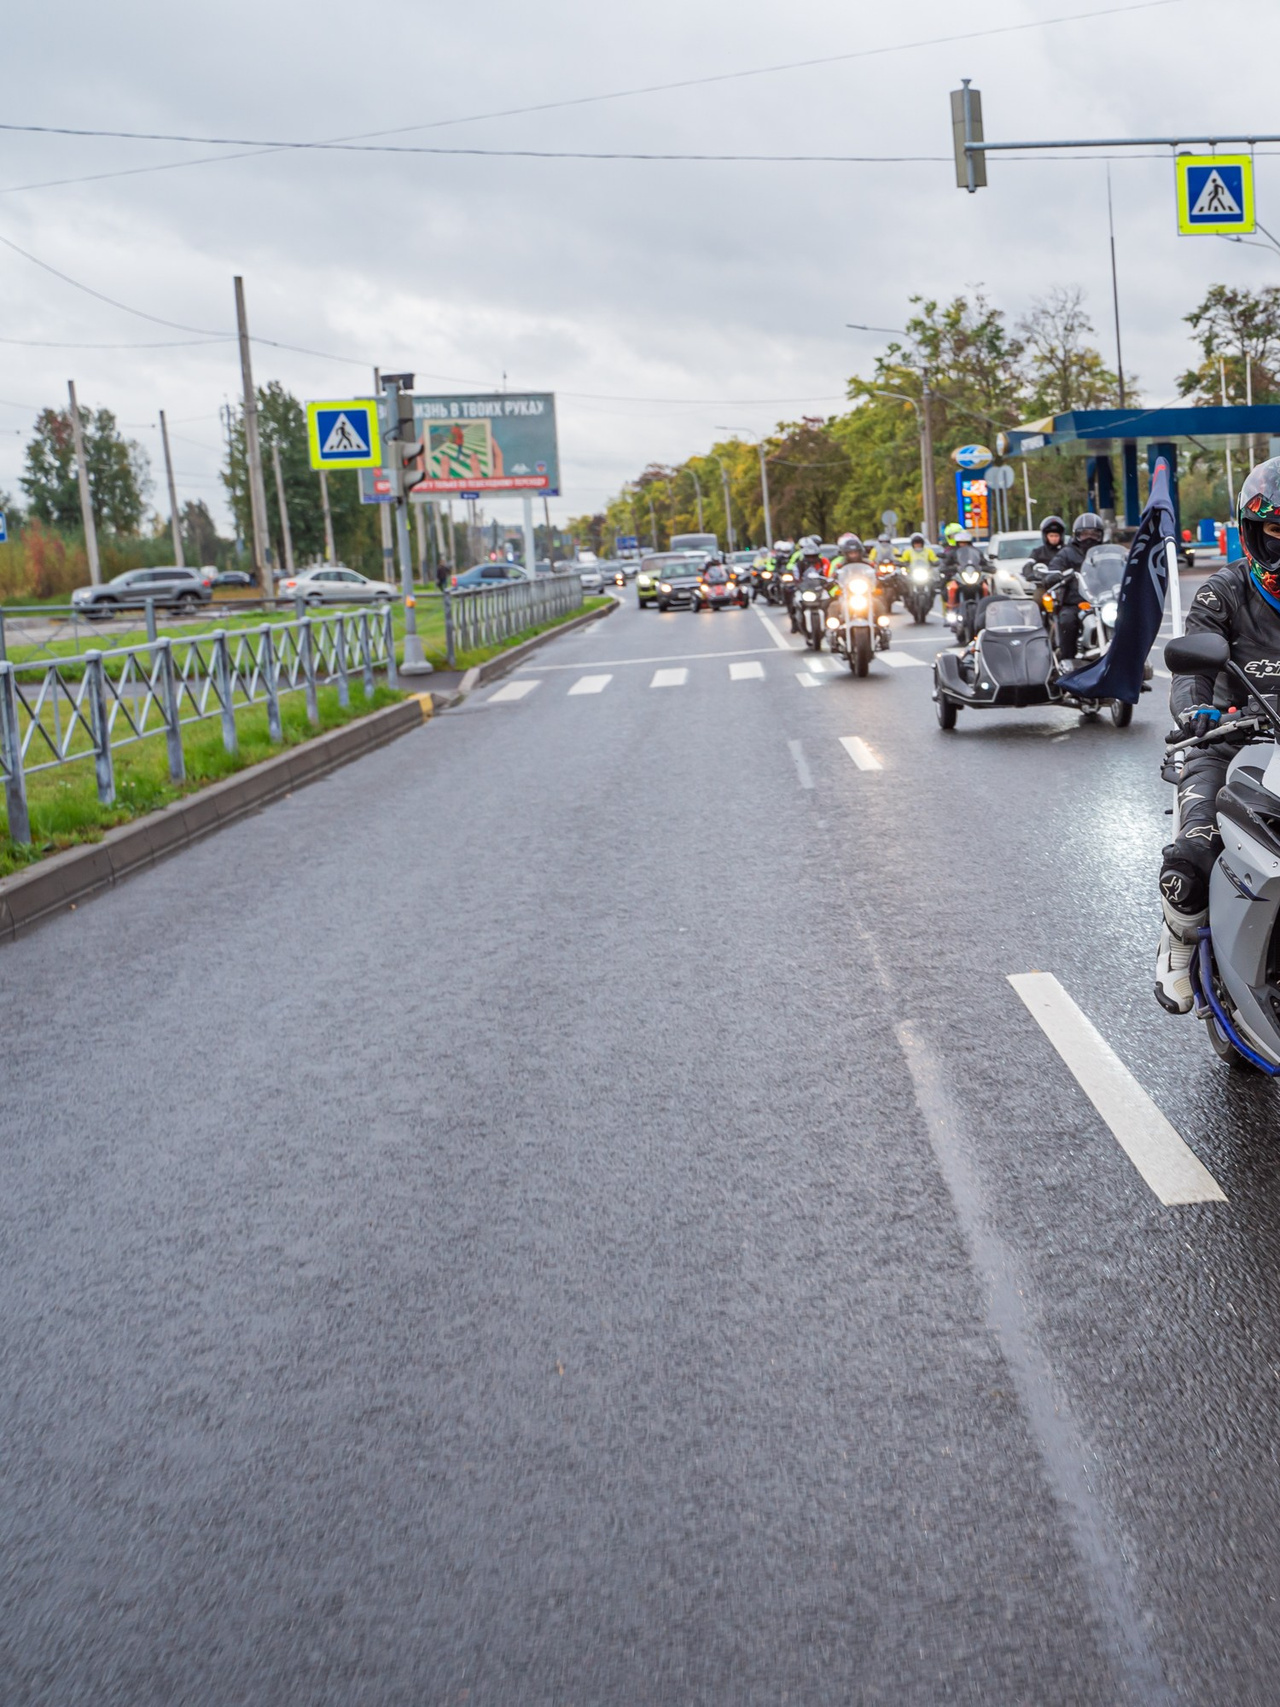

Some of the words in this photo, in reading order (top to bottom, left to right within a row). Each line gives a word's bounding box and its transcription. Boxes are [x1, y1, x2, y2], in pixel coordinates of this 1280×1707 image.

[414, 403, 448, 418] ИЗНЬ
[450, 401, 460, 416] В
[462, 401, 503, 417] ТВОИХ
[504, 400, 544, 416] РУКАХ
